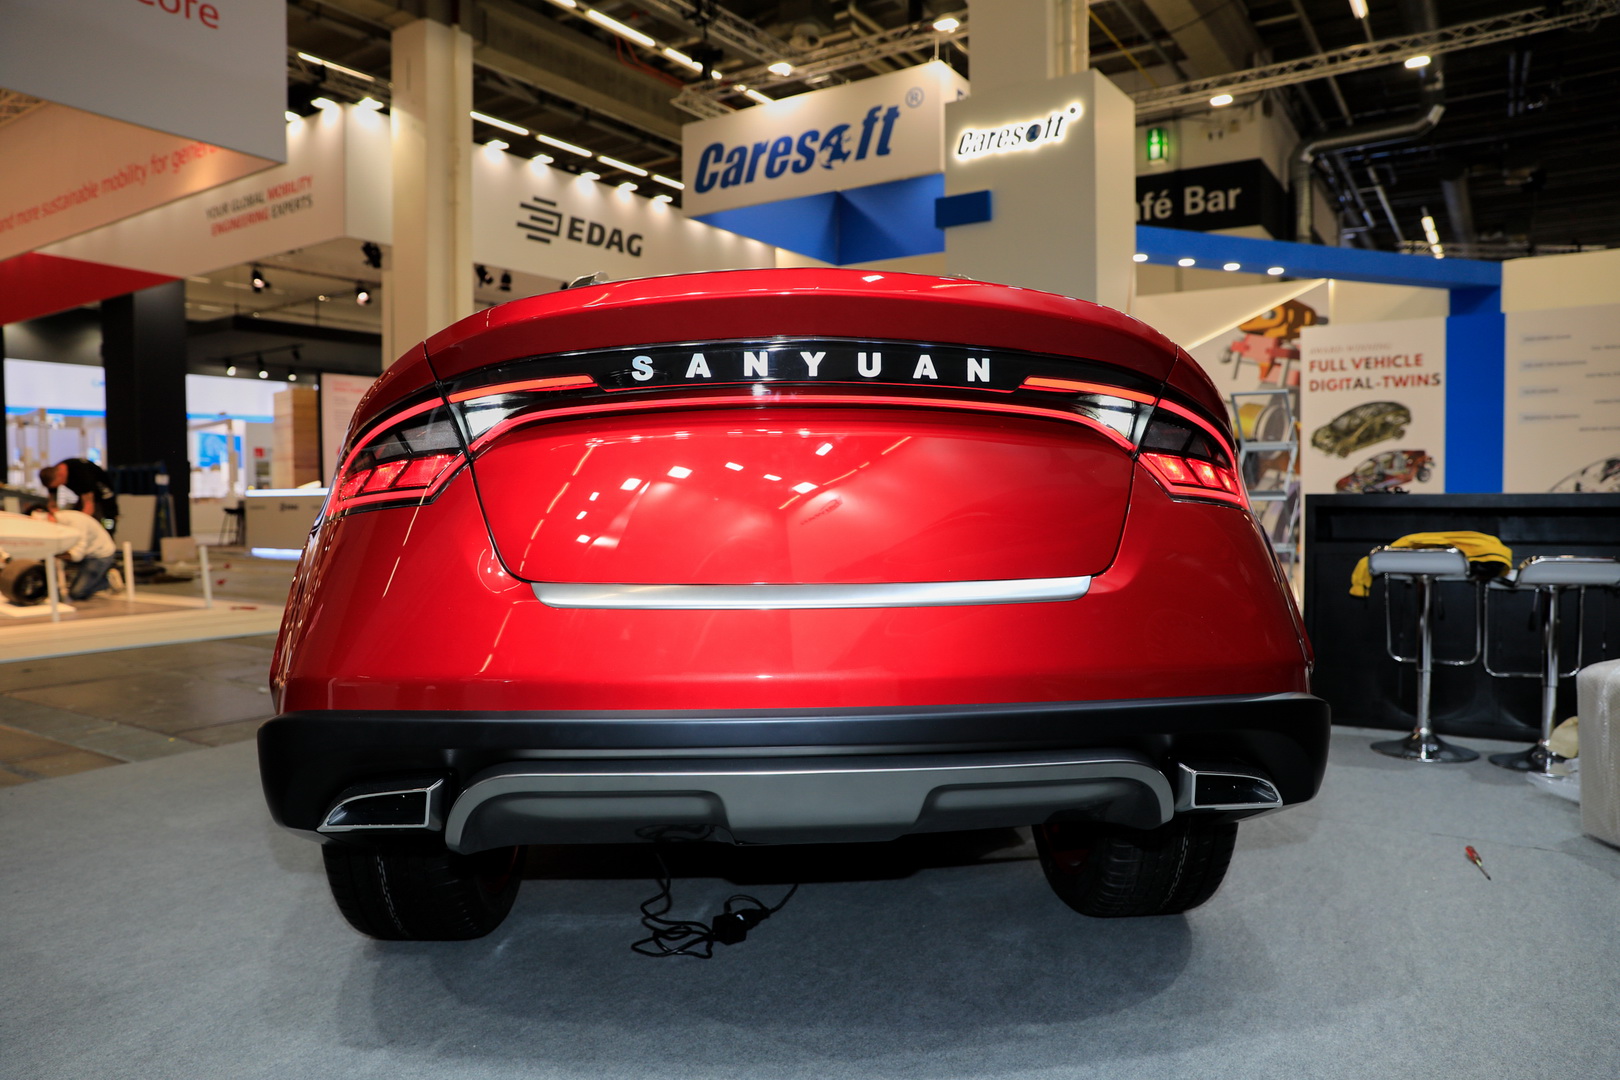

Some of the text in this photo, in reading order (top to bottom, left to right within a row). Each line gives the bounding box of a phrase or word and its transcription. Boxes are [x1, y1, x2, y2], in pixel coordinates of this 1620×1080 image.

[137, 0, 219, 29] ore
[694, 103, 901, 194] Caresoft
[101, 162, 147, 193] mobility
[151, 153, 168, 175] for
[266, 174, 313, 201] MOBILITY
[211, 193, 313, 237] ENGINEERING EXPERTS
[1136, 186, 1242, 221] fé Bar
[567, 218, 644, 257] EDAG
[631, 351, 991, 382] SANYUAN
[1309, 353, 1424, 373] FULL VEHICLE
